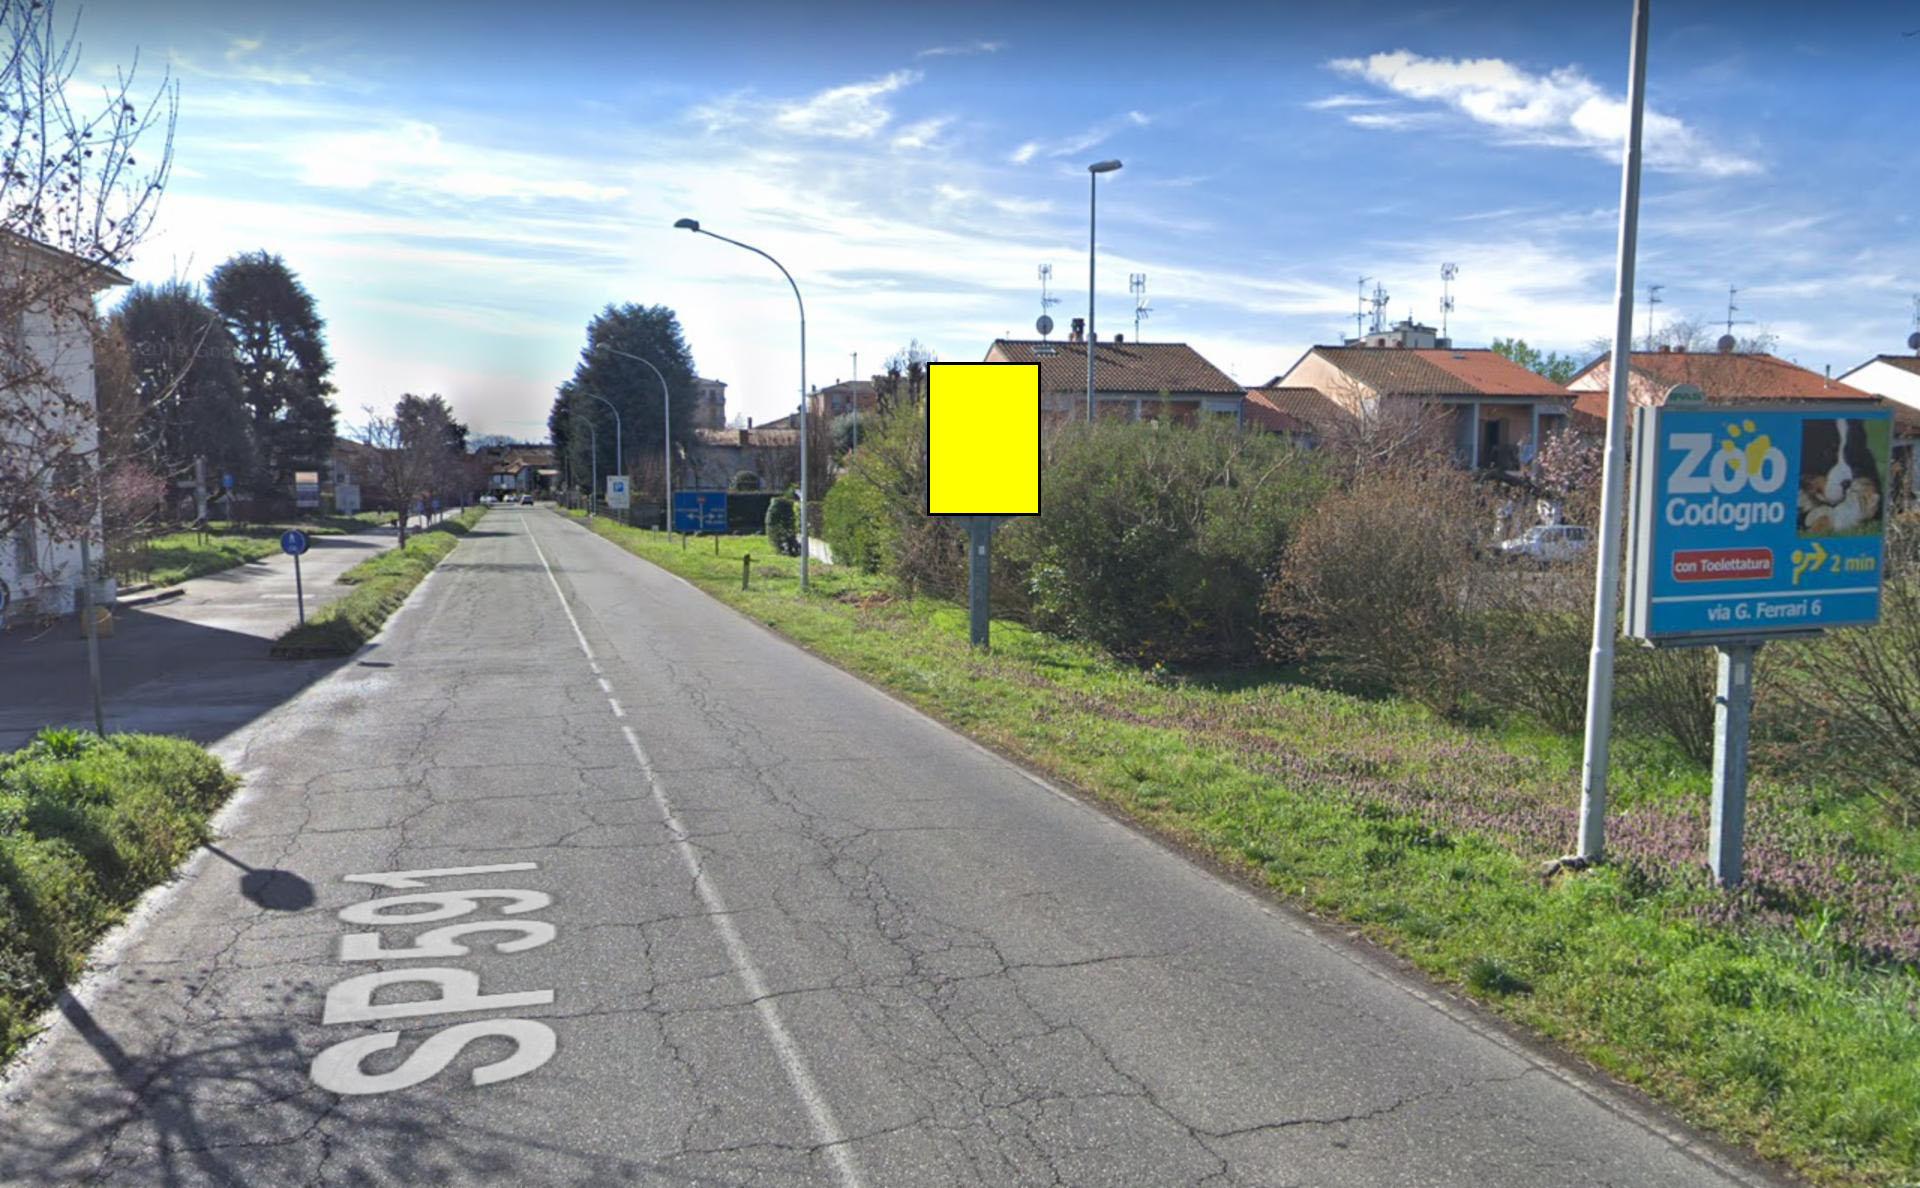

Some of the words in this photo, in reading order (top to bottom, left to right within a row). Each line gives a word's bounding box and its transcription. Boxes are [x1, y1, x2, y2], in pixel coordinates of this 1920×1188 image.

[1665, 498, 1785, 531] Codogno
[1675, 562, 1697, 573] con
[1700, 557, 1771, 572] Toelettatura
[1830, 554, 1841, 573] 2
[1845, 552, 1876, 572] min
[1707, 603, 1731, 621] via
[1735, 602, 1751, 620] G.
[1756, 599, 1807, 619] Ferrari
[1811, 599, 1822, 616] 6
[310, 862, 557, 1096] SP591
